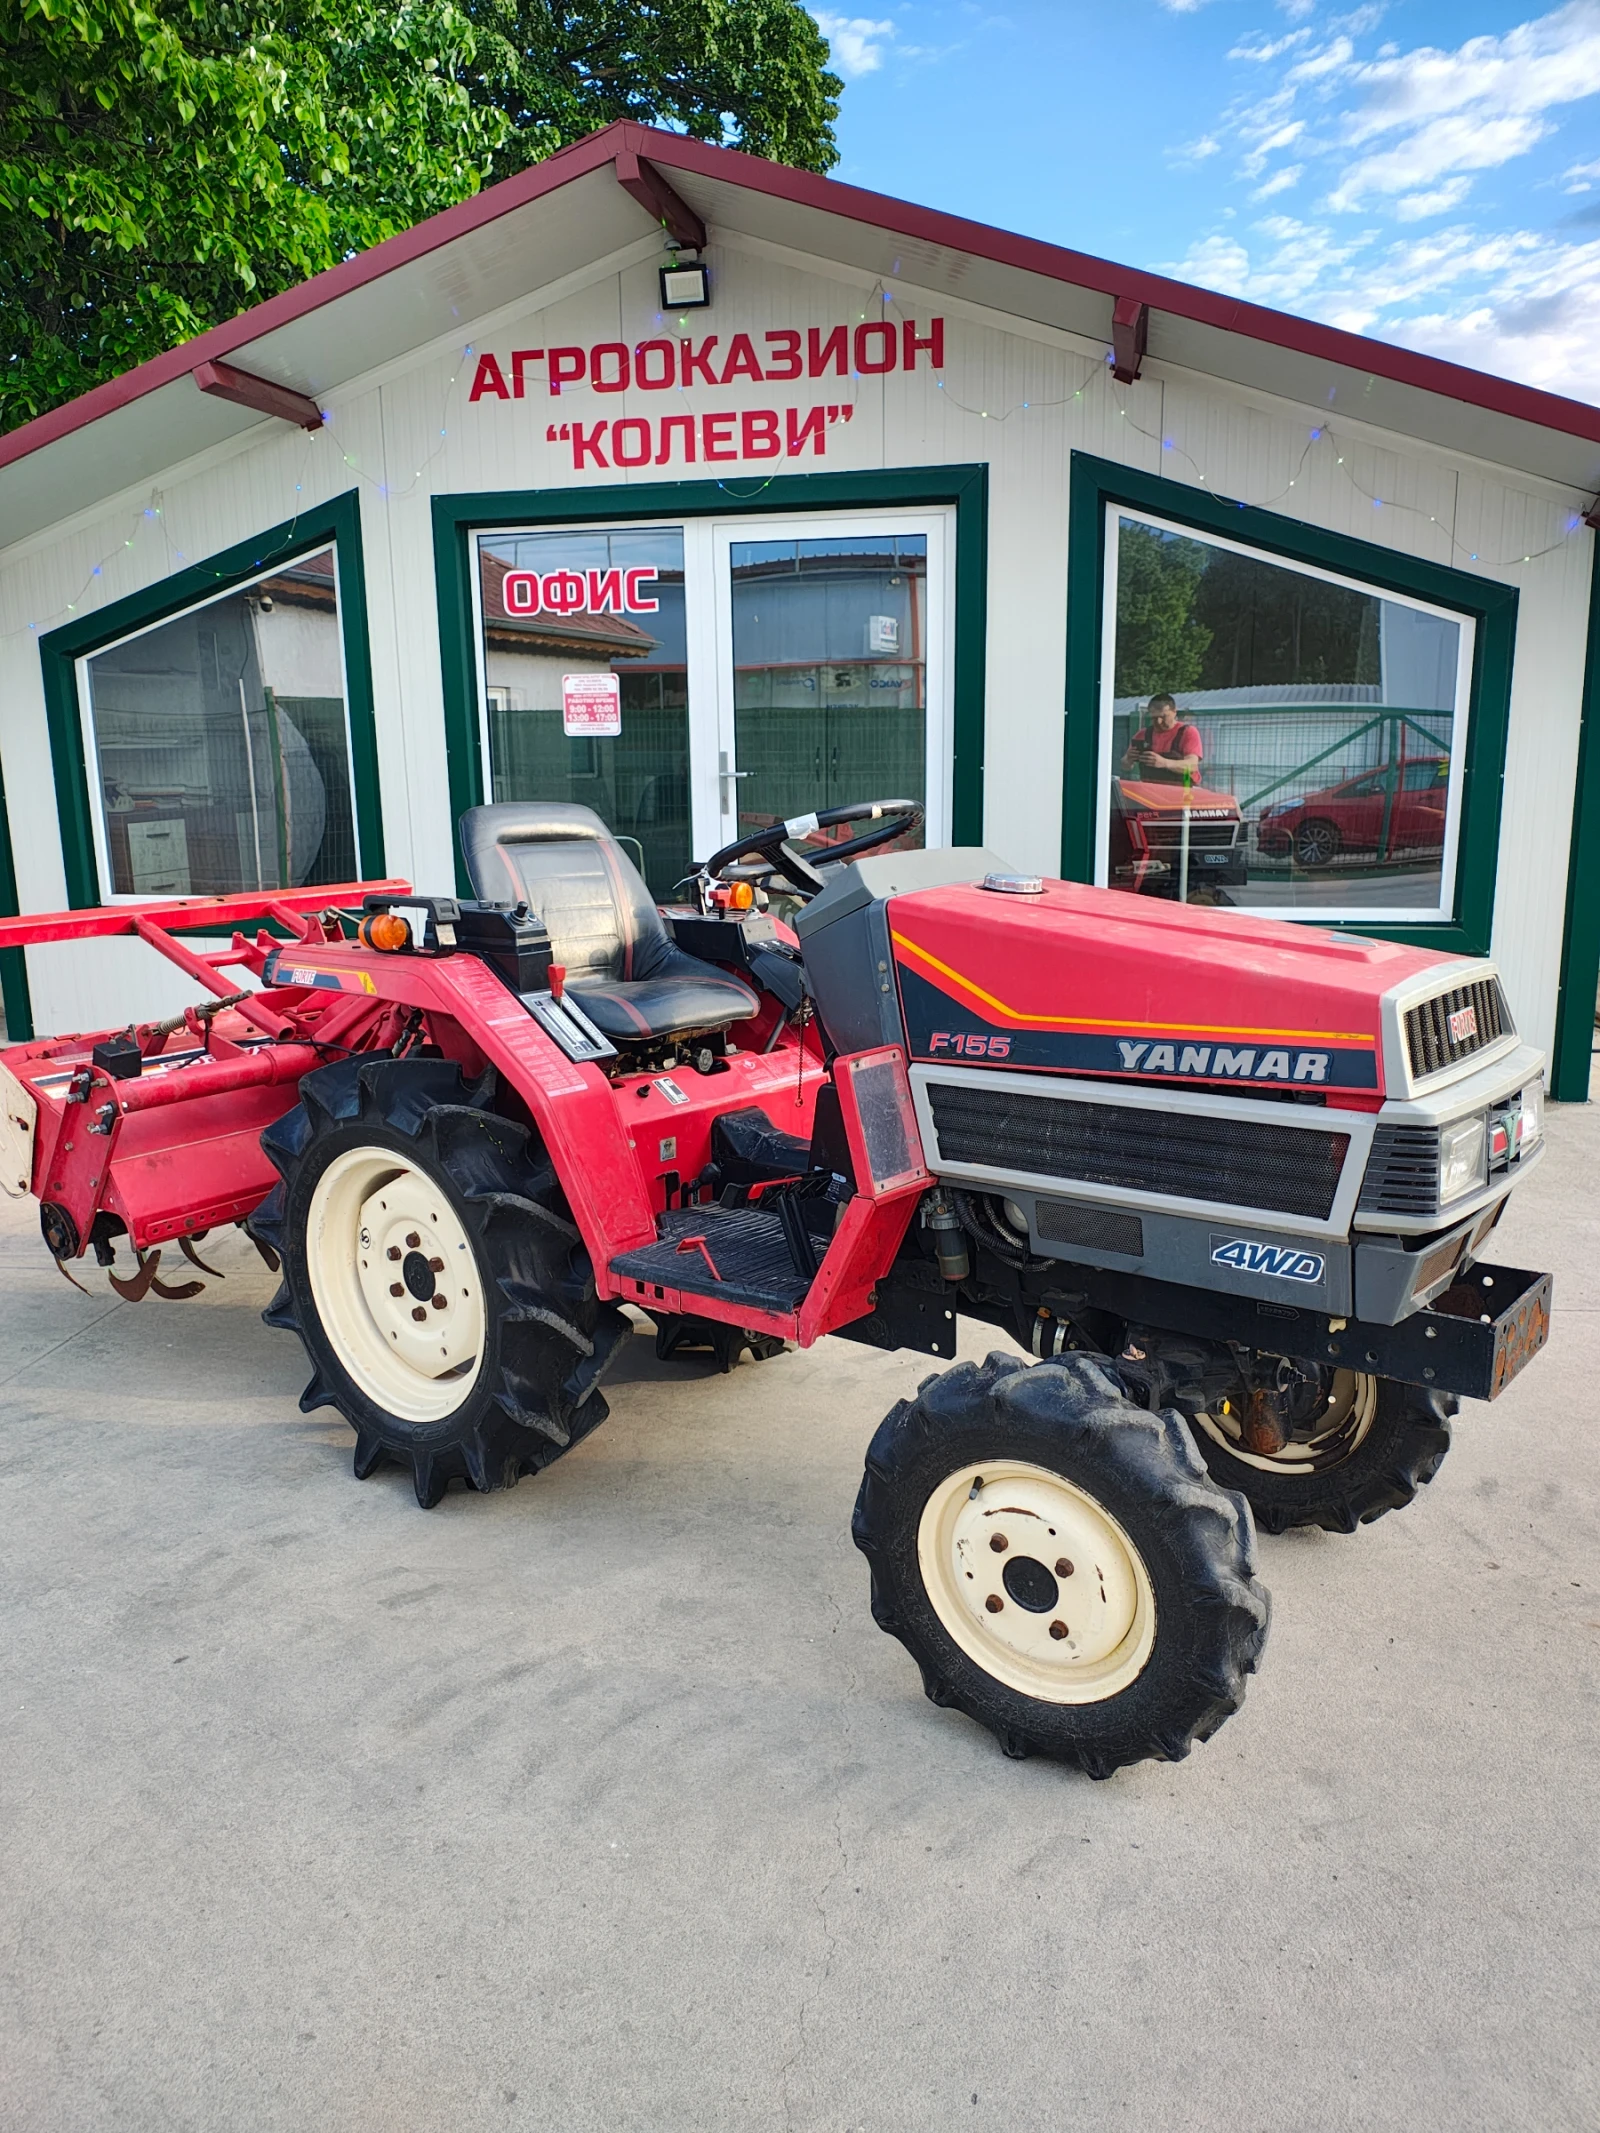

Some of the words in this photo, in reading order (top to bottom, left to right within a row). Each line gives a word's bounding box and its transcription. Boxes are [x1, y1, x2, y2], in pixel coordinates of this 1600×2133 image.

[468, 317, 945, 402] АГРООКАЗИОН
[503, 567, 659, 616] ОФИС
[292, 968, 317, 985] FORTE
[929, 1032, 1011, 1057] F155
[1118, 1040, 1331, 1082] YANMAR
[1212, 1240, 1325, 1283] 4WD
